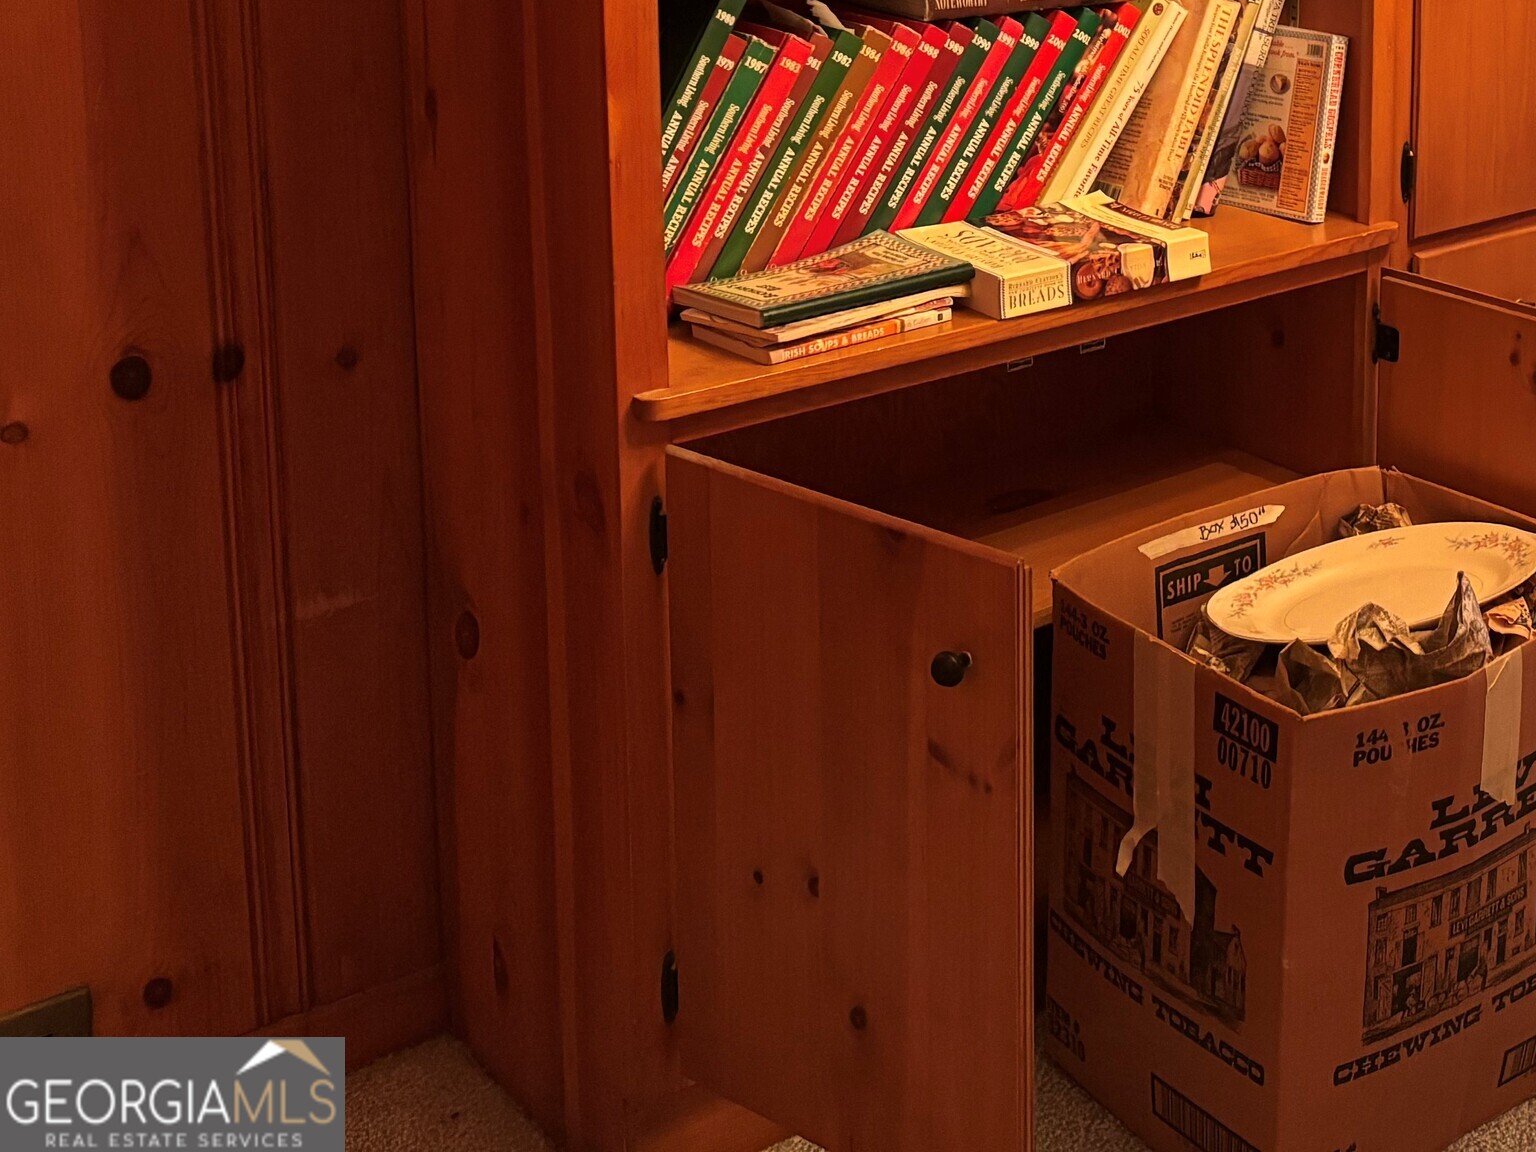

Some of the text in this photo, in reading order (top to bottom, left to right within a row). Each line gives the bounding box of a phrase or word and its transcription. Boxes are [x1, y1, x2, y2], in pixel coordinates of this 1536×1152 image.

[715, 9, 736, 26] 1980
[1072, 28, 1091, 46] 2001
[1213, 8, 1231, 39] THE
[831, 50, 853, 68] 1982
[859, 44, 881, 63] 1984
[918, 41, 940, 59] 1988
[944, 38, 964, 56] 1989
[971, 33, 992, 51] 1990
[997, 31, 1016, 48] 1991
[690, 55, 710, 85] Southern
[744, 56, 769, 74] 1987
[780, 56, 802, 74] 1983
[805, 56, 822, 71] 981
[1188, 39, 1221, 115] SPLENDID
[1328, 51, 1343, 106] CORNBREAD
[677, 83, 697, 108] Living
[1133, 80, 1145, 94] 75
[859, 80, 938, 215] Southern Living ANNUAL RECIPES
[887, 75, 966, 209] Southern Living ANNUAL RECIPES
[1016, 111, 1043, 151] ANNUAL
[1036, 104, 1084, 183] ANNUAL RECIPES
[1173, 117, 1195, 162] TABLE
[681, 103, 740, 204] Southern Living ANNUAL
[744, 95, 825, 235] Southern Living ANNUAL RECIPES
[773, 90, 853, 228] Southern Living ANNUAL RECIPES
[913, 123, 962, 205] ANNUAL RECIPES
[940, 118, 990, 201] ANNUAL RECIPES
[967, 118, 1017, 199] ANNUAL RECIPES
[994, 151, 1022, 193] RECIPES
[714, 150, 765, 239] ANNUAL RECIPES
[803, 135, 855, 222] ANNUAL RECIPES
[831, 135, 882, 220] ANNUAL RECIPES
[1073, 165, 1099, 198] Favorite
[692, 158, 743, 248] ANNUAL RECIPES
[1009, 285, 1066, 310] BREADS
[782, 327, 885, 360] IRISH SOUPS & BREADS
[1167, 555, 1252, 600] SHIP TO
[1220, 702, 1271, 753] 42100
[1217, 736, 1272, 790] 00710
[1507, 886, 1525, 903] SONS
[1050, 907, 1144, 1005] CHEWING
[1152, 993, 1265, 1086] TOBACCO
[1332, 1003, 1482, 1087] CHEWING
